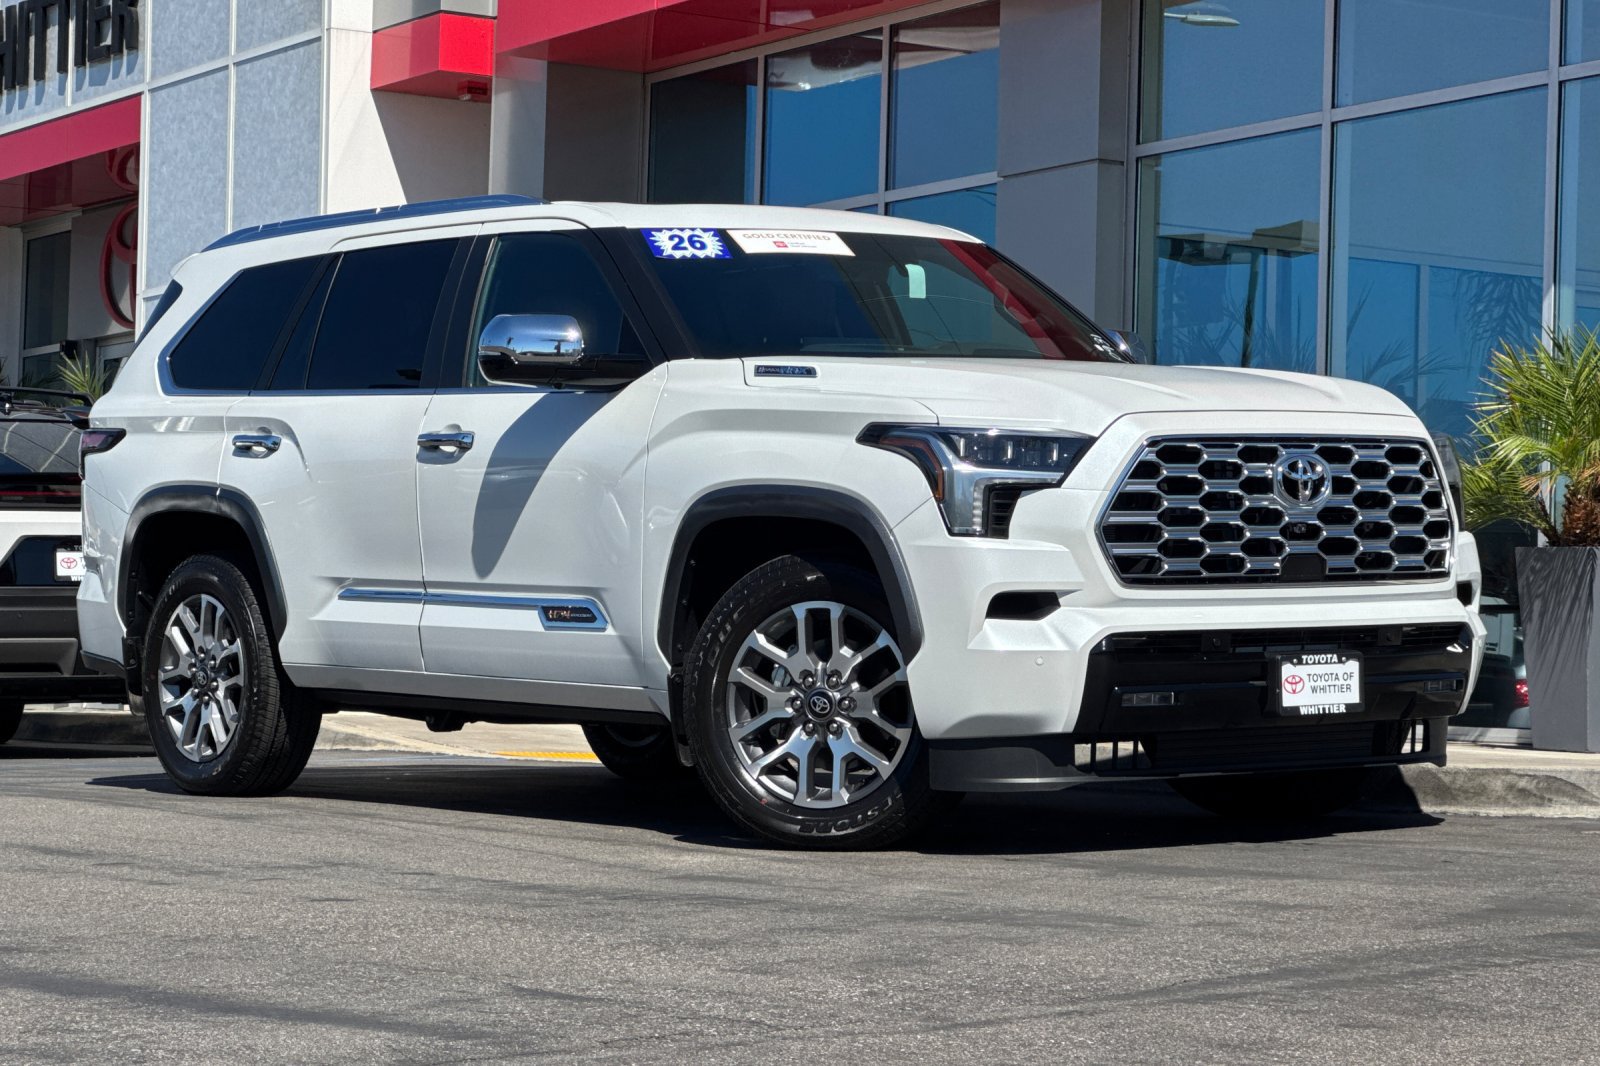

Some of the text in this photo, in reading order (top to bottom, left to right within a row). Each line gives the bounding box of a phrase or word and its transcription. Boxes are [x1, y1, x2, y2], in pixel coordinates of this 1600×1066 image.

[668, 233, 708, 251] 26
[776, 233, 831, 241] CERTIFIED
[1301, 654, 1338, 664] TOYOTA
[1307, 672, 1354, 683] TOYOTA OF
[1310, 684, 1352, 694] WHITTIER
[1300, 704, 1346, 715] WHITTIER
